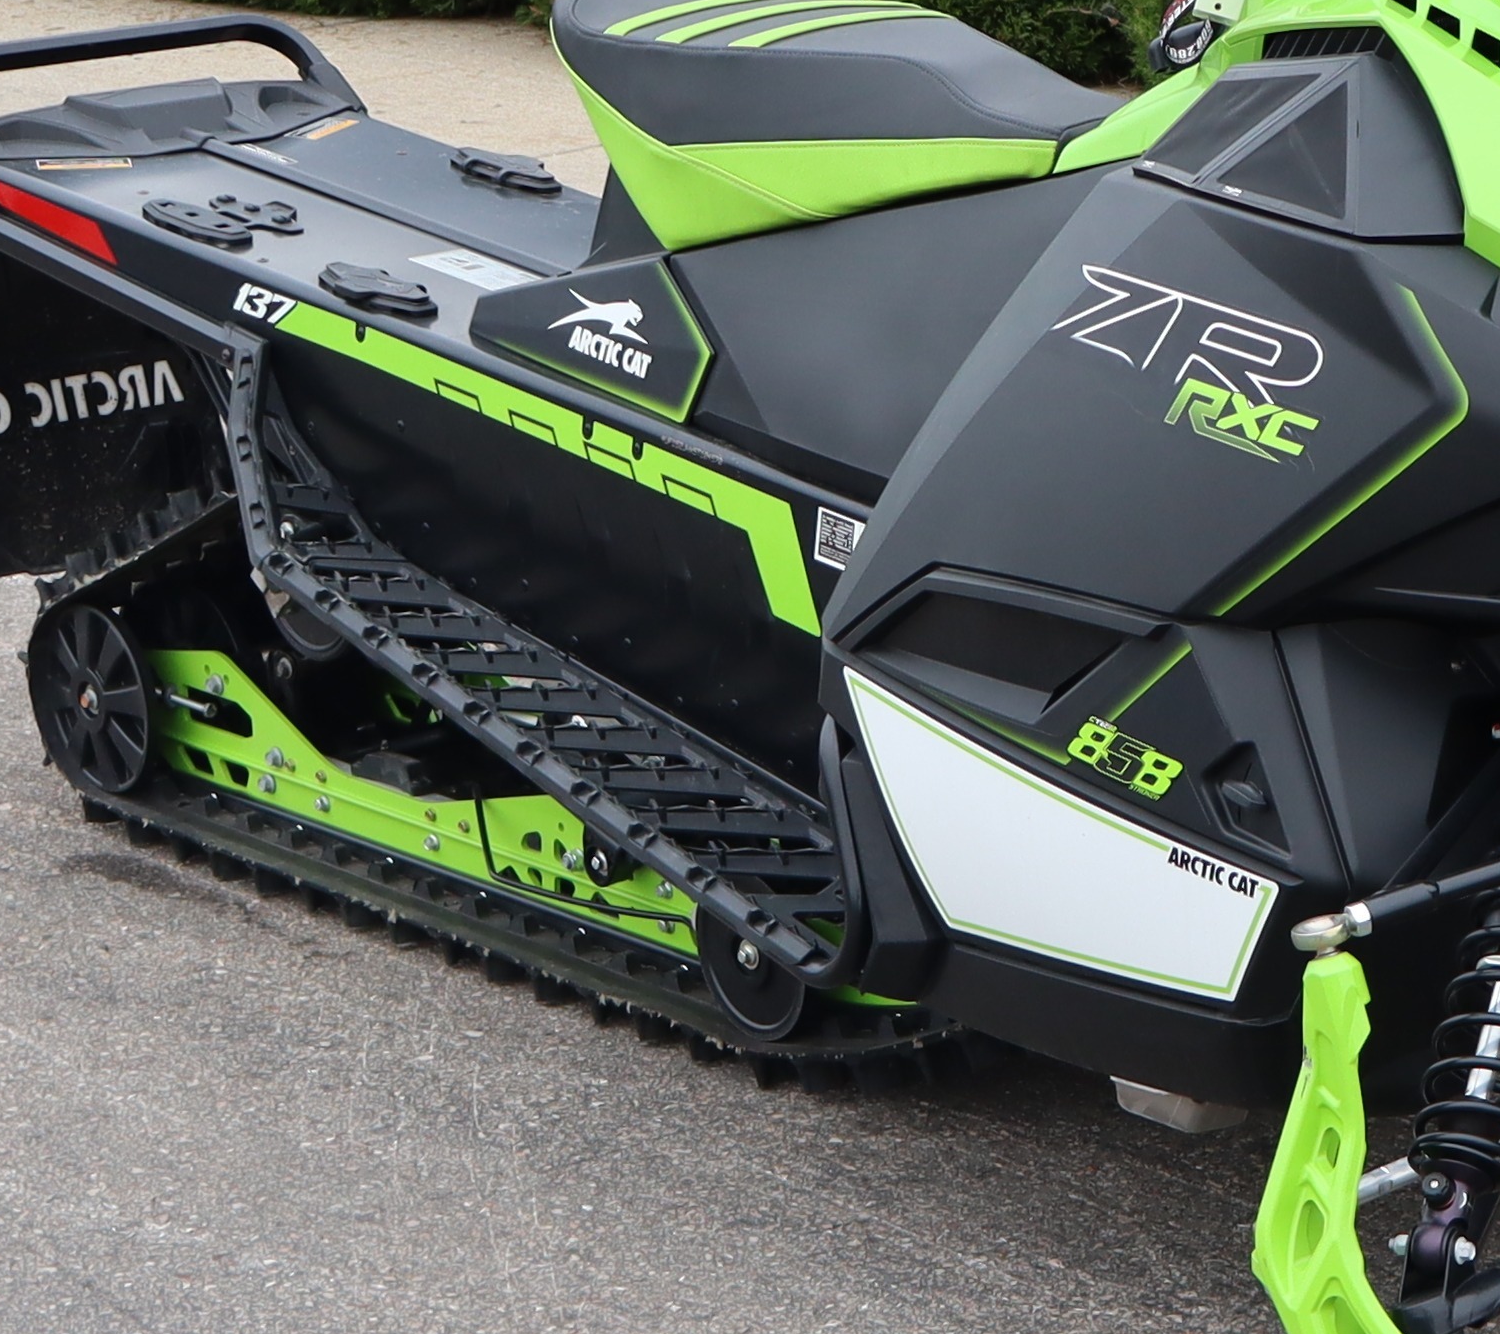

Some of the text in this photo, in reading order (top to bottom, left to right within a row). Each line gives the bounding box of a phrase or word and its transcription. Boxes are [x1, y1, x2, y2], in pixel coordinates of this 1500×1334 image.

[233, 282, 297, 324] 137
[1050, 264, 1324, 405] ZR
[568, 325, 652, 379] ARCTIC CAT
[1163, 377, 1320, 463] RXC
[1067, 721, 1184, 795] 858
[1167, 846, 1260, 898] ARCTIC CAT
